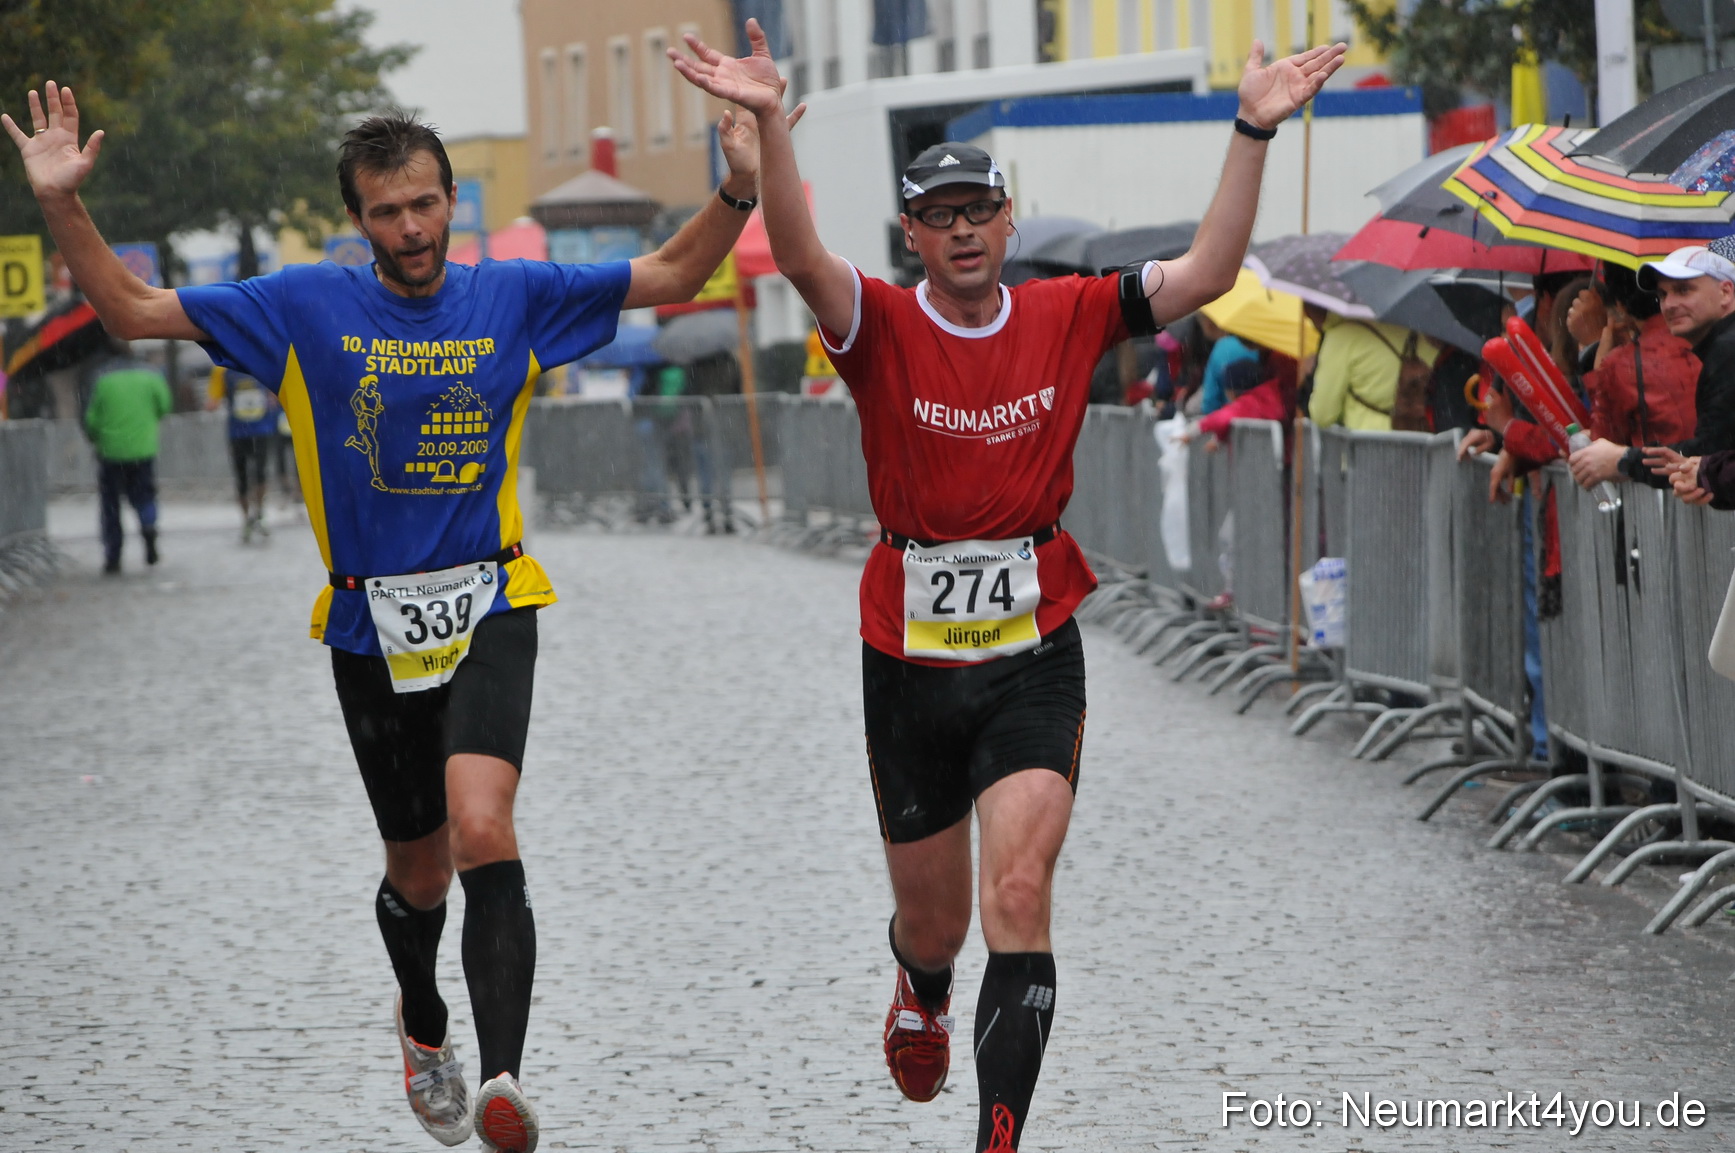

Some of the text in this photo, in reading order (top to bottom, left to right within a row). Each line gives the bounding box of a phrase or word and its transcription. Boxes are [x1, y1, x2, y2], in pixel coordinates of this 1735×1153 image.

[3, 261, 29, 297] D
[341, 335, 495, 358] 10. NEUMARKTER
[365, 355, 477, 376] STADTLAUF
[913, 393, 1037, 433] NEUMARKT
[416, 439, 489, 456] 20.09.2009
[985, 430, 1017, 446] STARKE
[370, 576, 477, 601] PARTL Neumarkt
[930, 568, 1015, 615] 274
[400, 592, 473, 645] 339
[943, 627, 1001, 647] Jürgen
